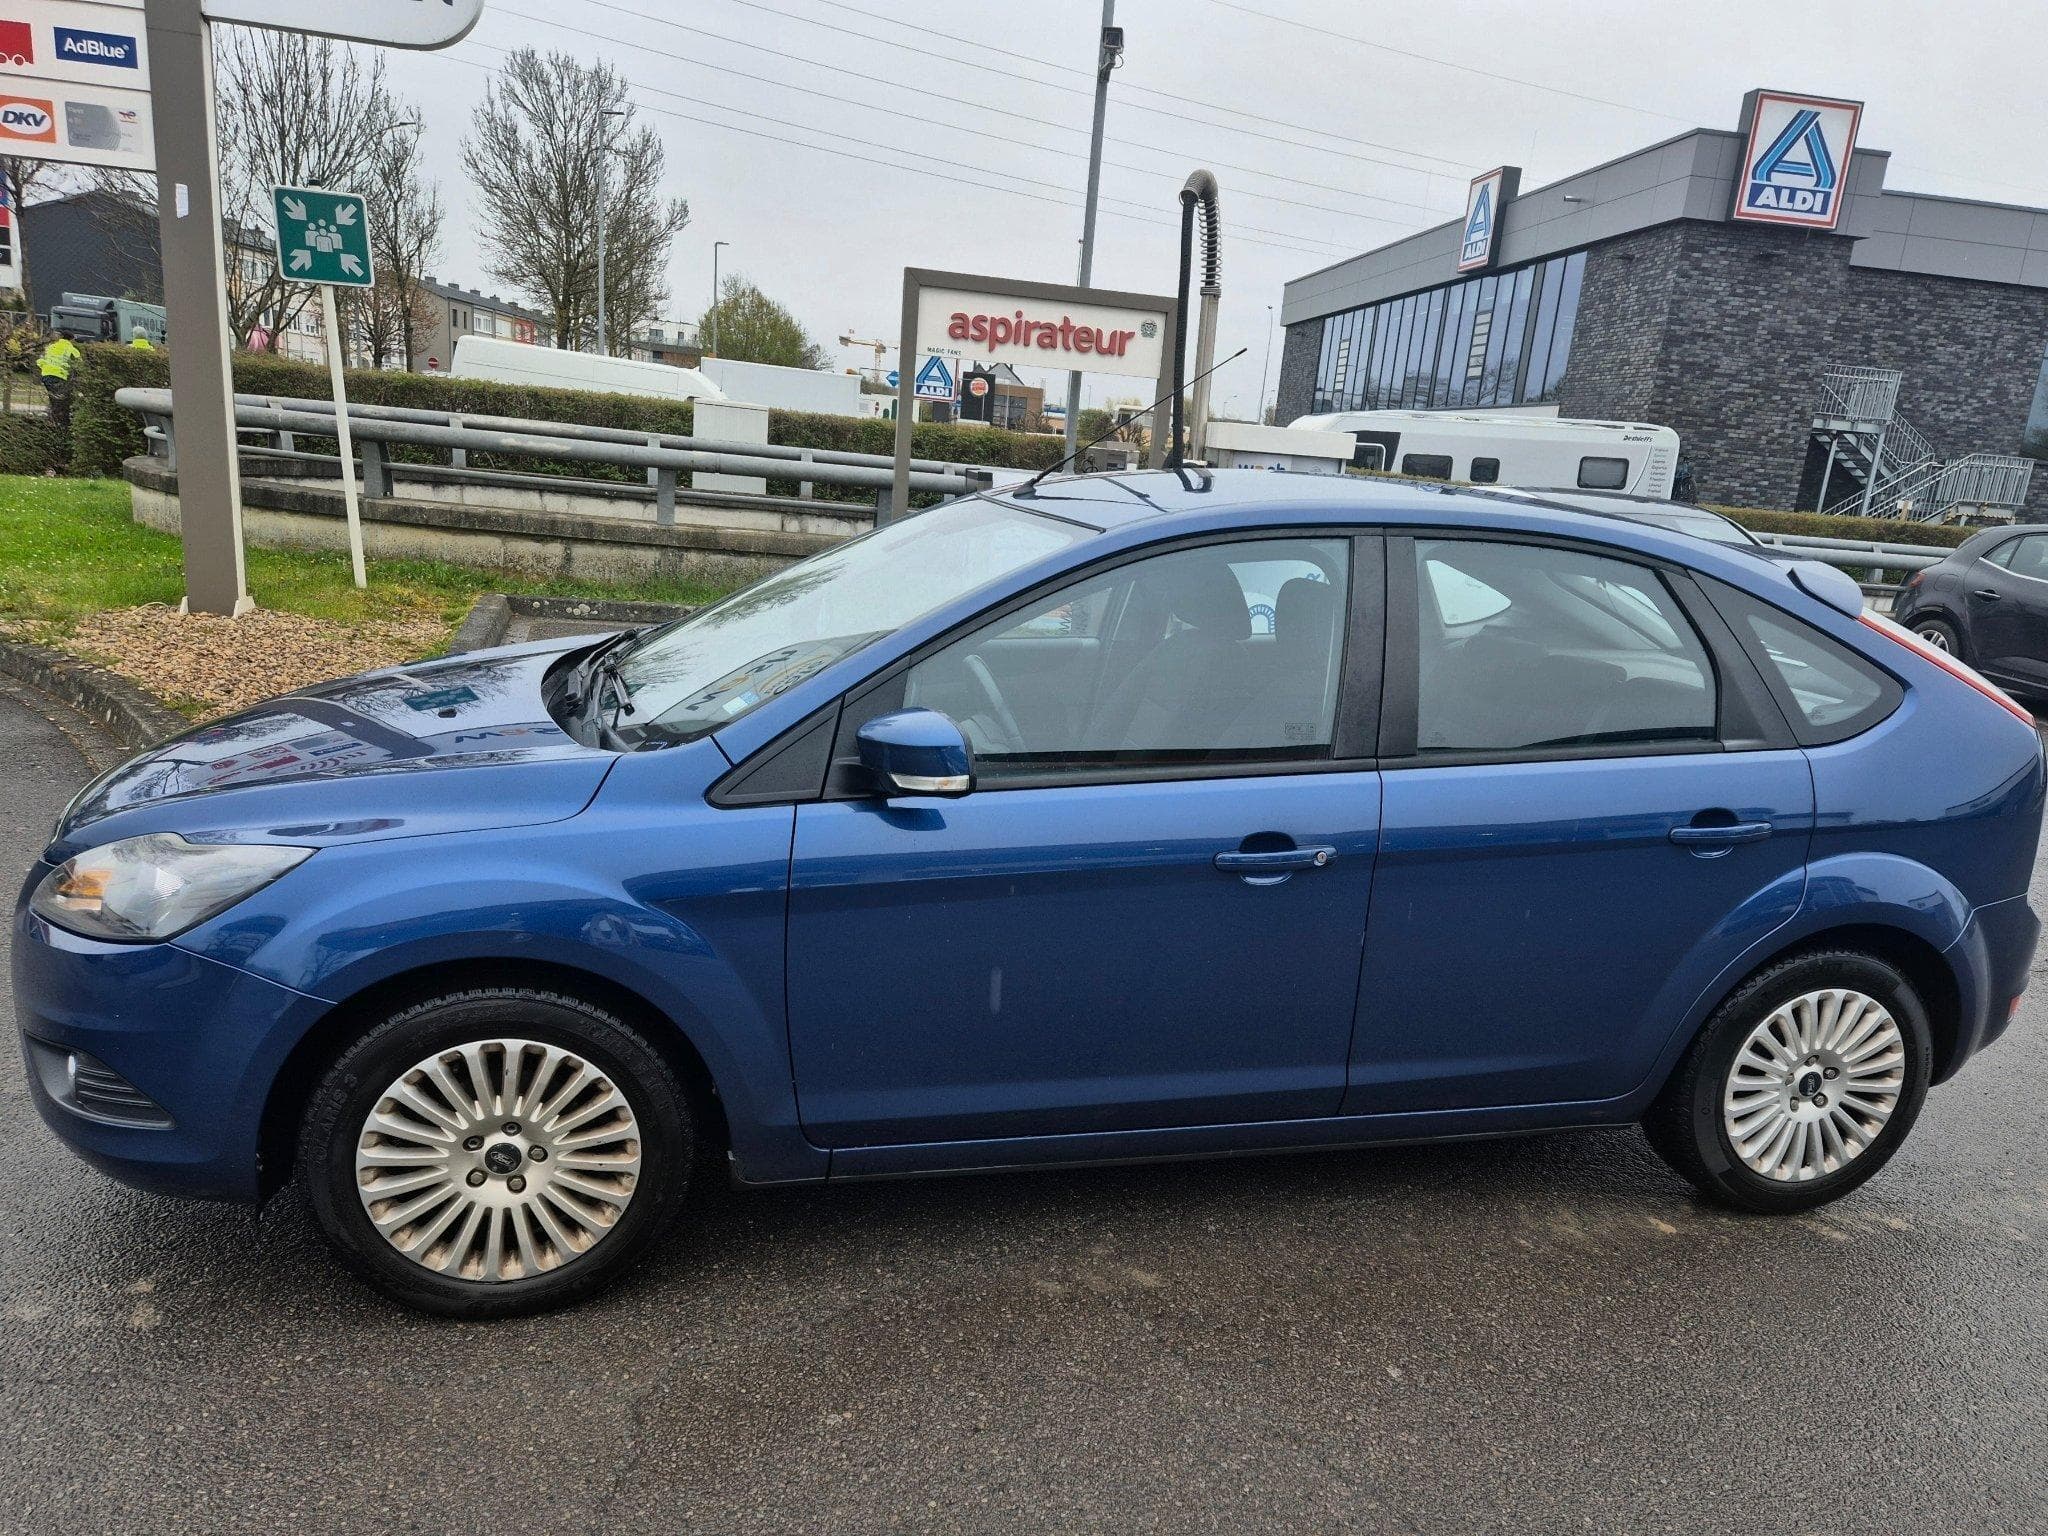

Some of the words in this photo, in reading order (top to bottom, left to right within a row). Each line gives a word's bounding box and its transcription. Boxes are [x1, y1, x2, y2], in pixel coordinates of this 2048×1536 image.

[2, 110, 47, 127] DKV
[1754, 186, 1825, 213] ALDI
[1464, 240, 1487, 260] ALDI
[949, 310, 1136, 357] aspirateur
[919, 385, 950, 397] ALDI
